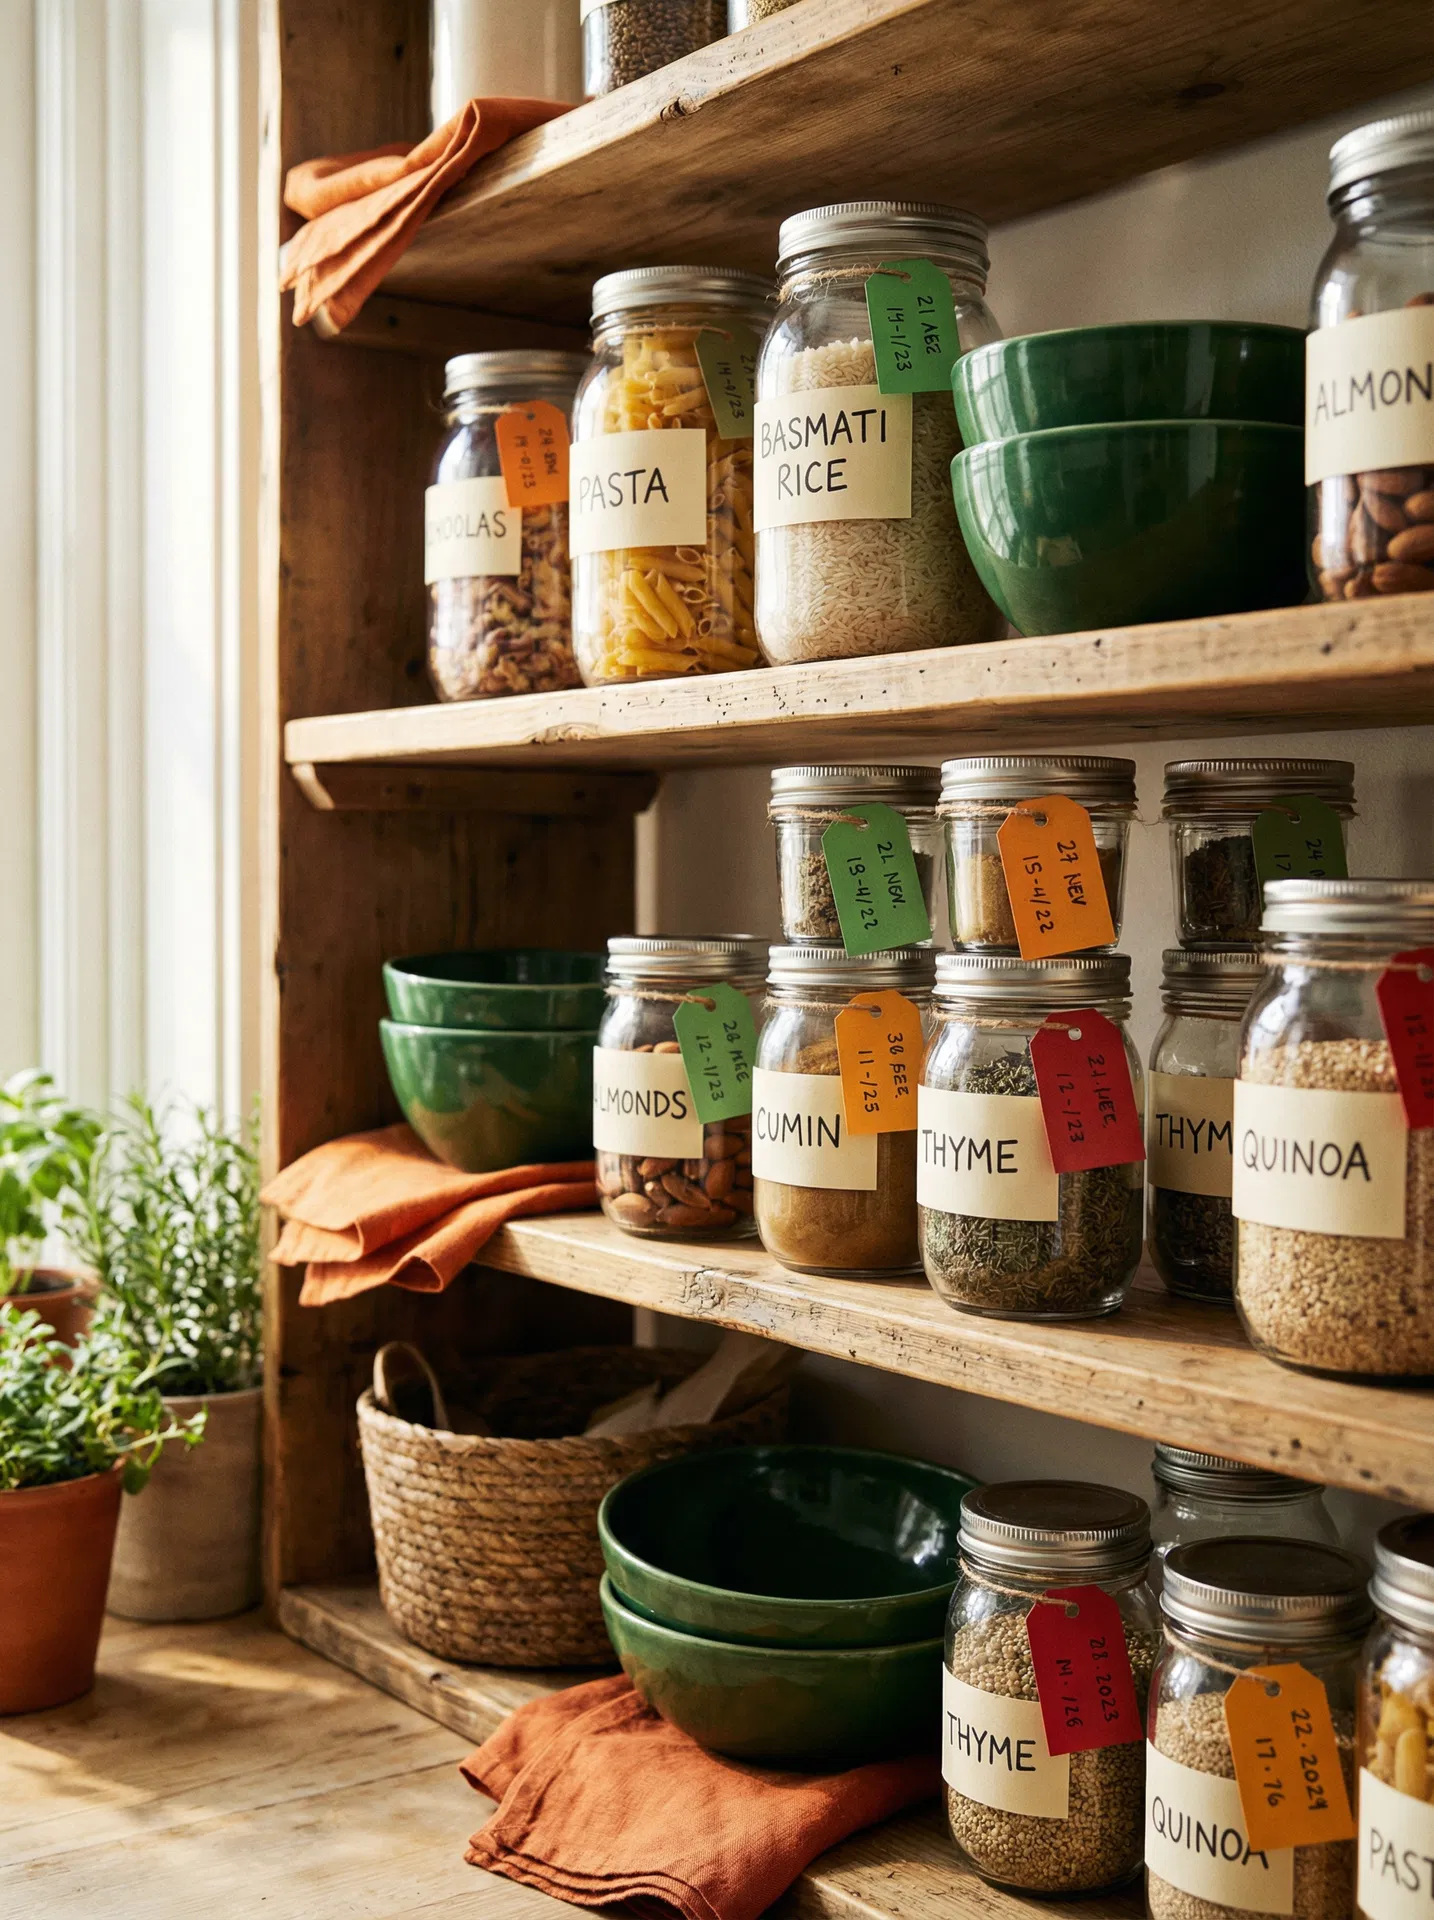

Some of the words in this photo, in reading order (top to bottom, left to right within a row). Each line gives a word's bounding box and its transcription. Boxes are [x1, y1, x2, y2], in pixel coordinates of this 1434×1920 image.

[1313, 360, 1434, 428] ALMON
[760, 408, 887, 459] BASMATI
[579, 467, 670, 514] PASTA
[777, 457, 849, 501] RICE
[756, 1106, 841, 1148] CUMIN
[922, 1129, 1019, 1174] THYME
[1242, 1129, 1372, 1182] QUINOA
[947, 1710, 1036, 1771] THYME
